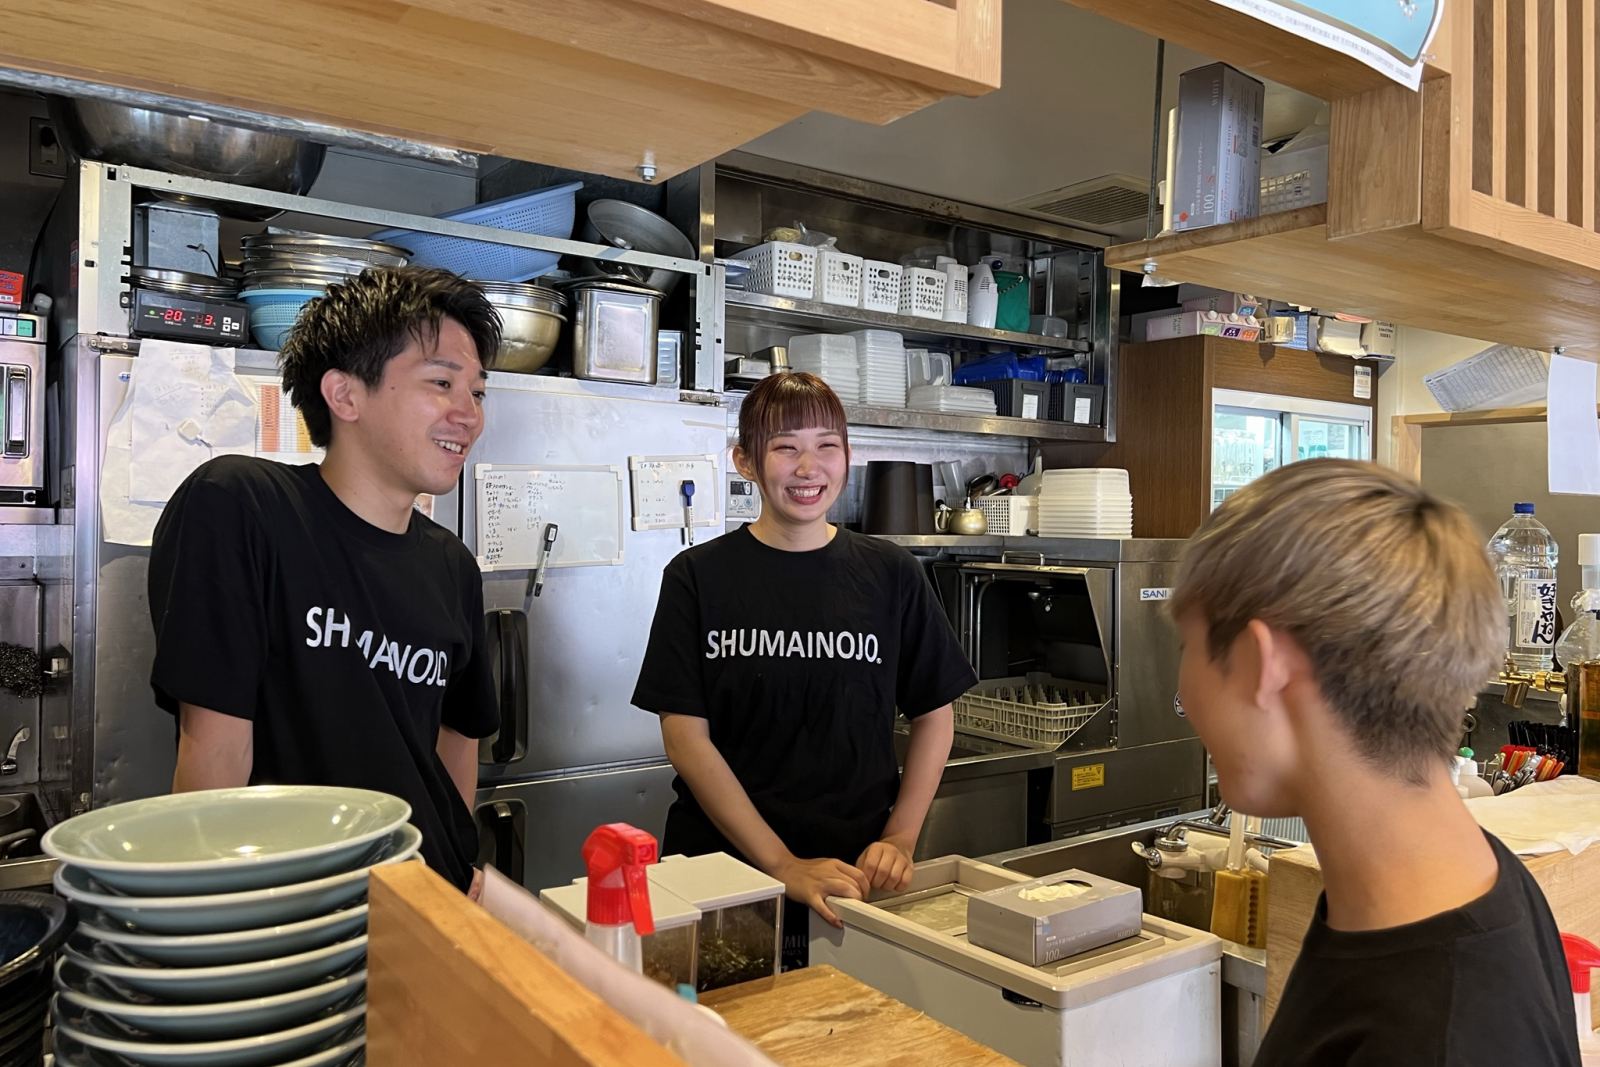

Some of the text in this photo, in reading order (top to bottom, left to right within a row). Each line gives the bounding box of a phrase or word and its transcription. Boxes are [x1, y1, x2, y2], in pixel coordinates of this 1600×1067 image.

[1204, 194, 1214, 215] 100
[1142, 590, 1167, 598] SANI
[1531, 583, 1556, 645] 好きやねん
